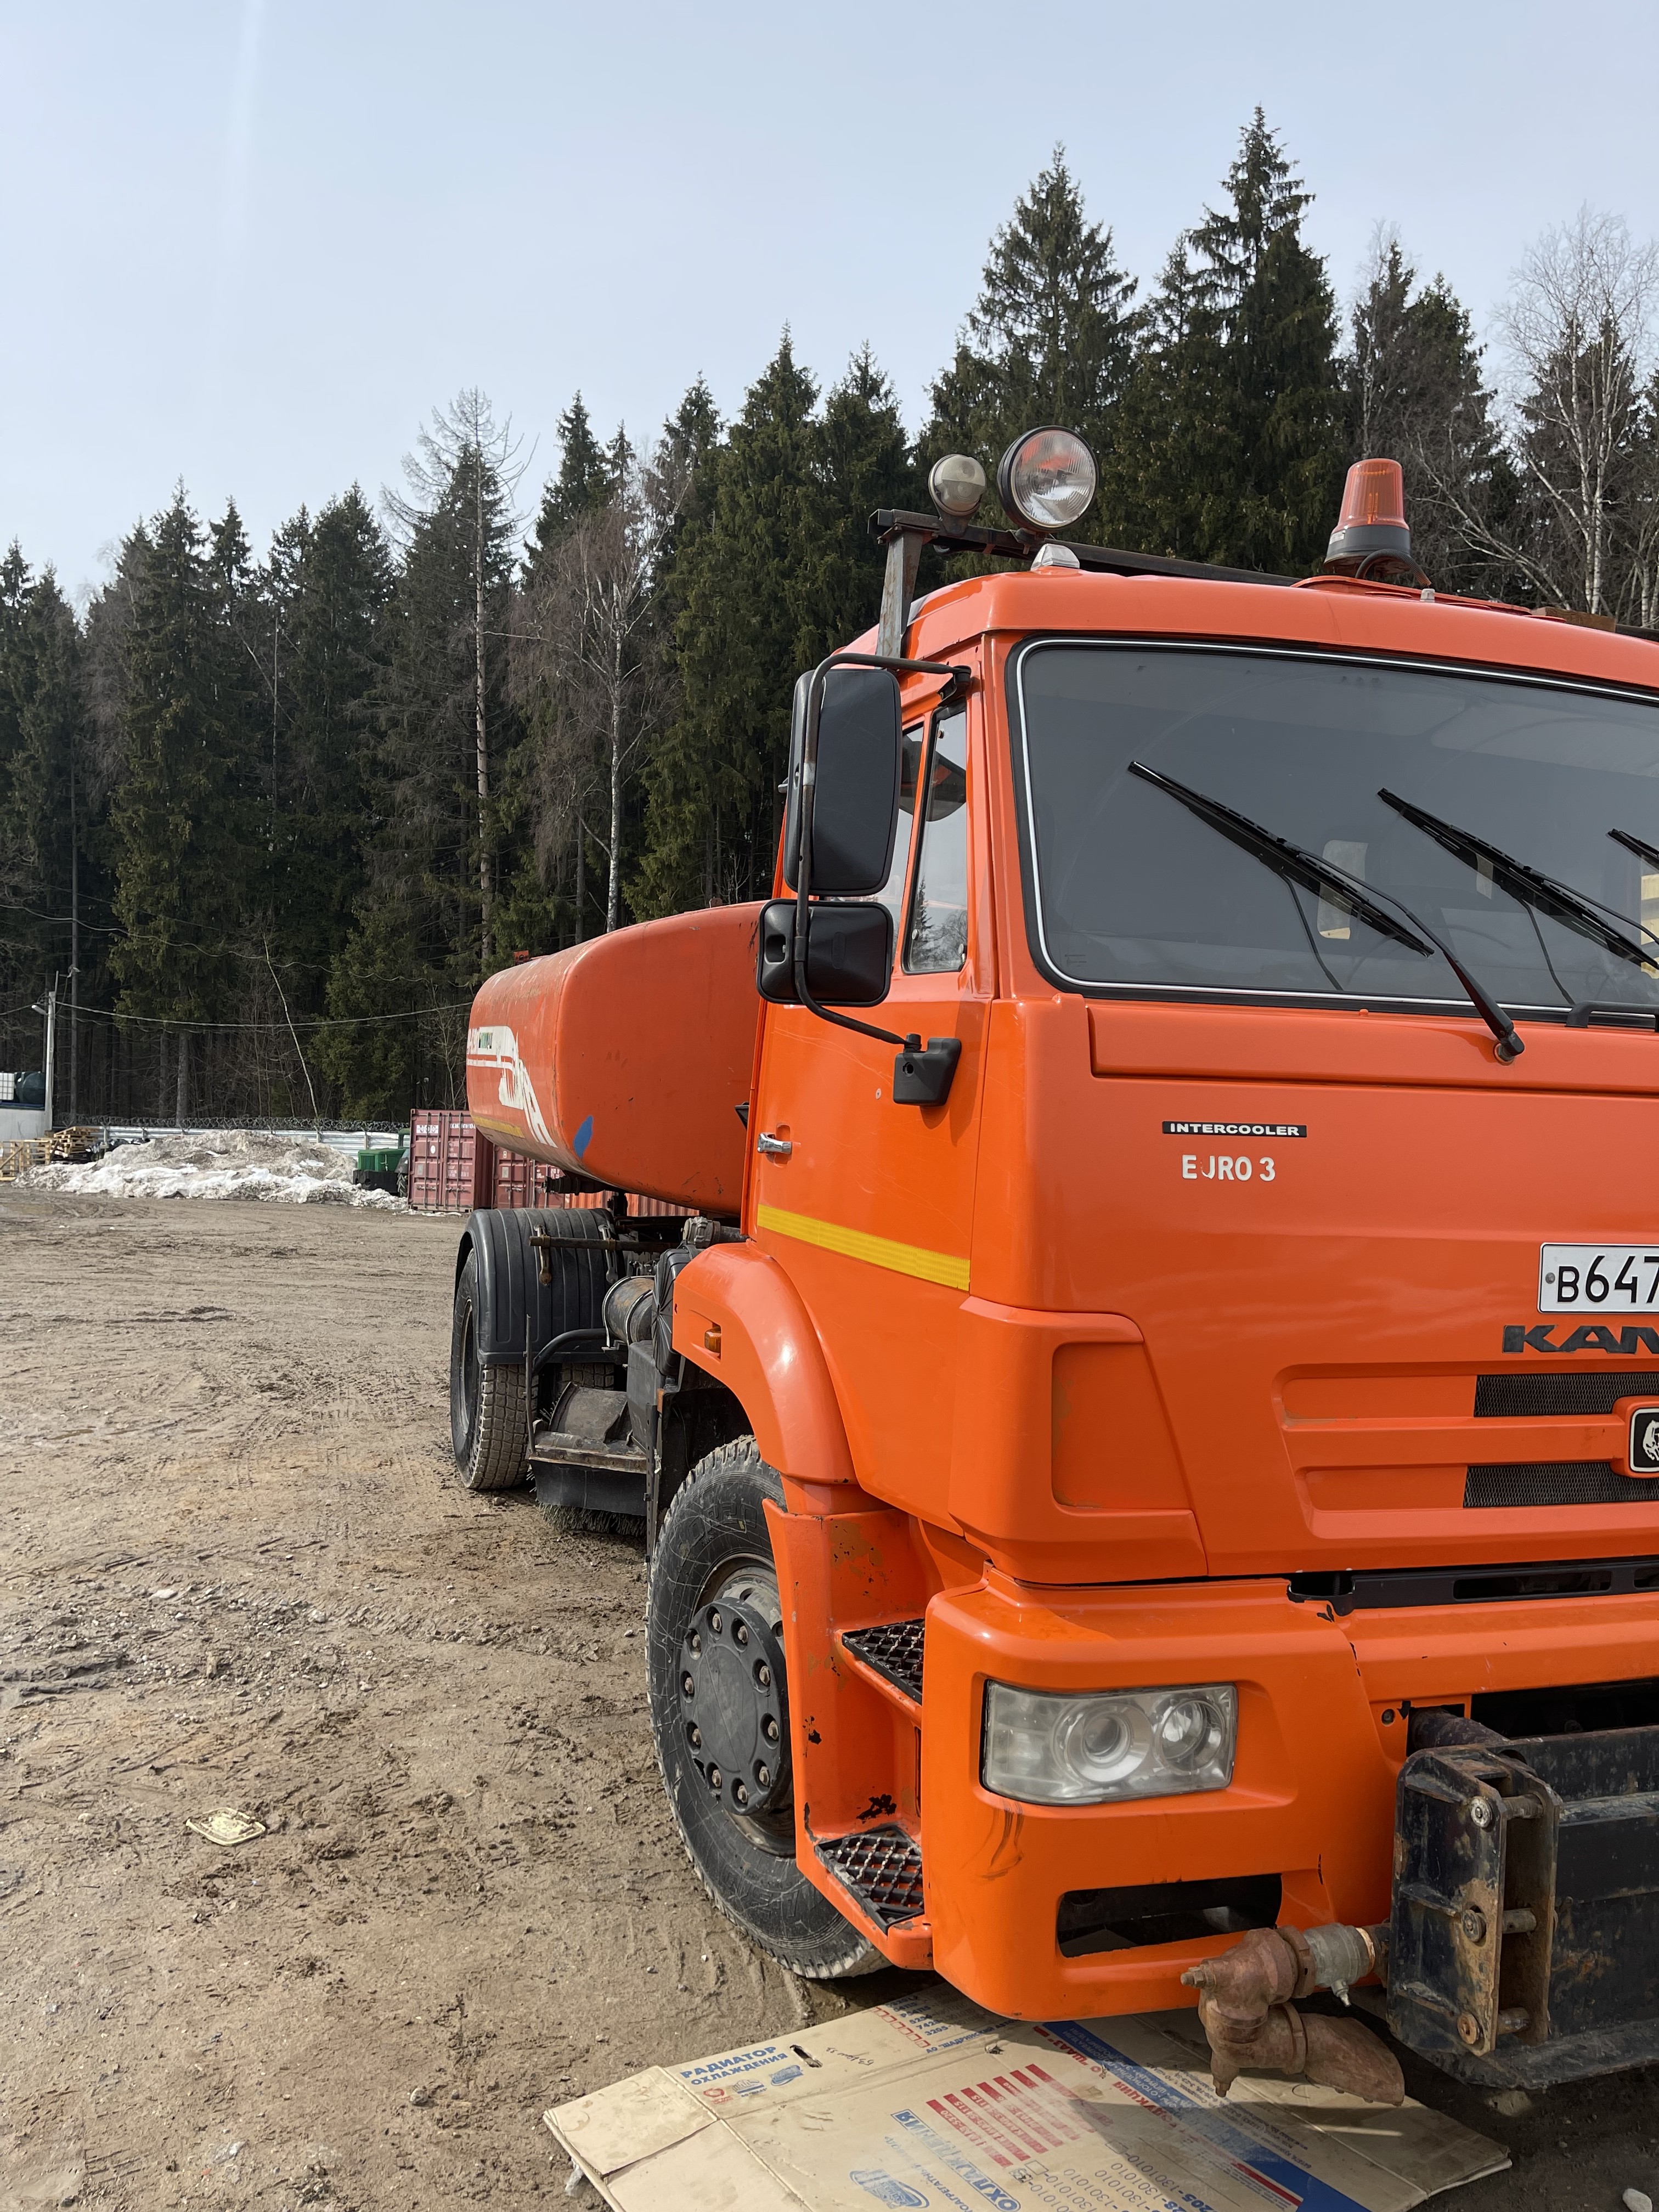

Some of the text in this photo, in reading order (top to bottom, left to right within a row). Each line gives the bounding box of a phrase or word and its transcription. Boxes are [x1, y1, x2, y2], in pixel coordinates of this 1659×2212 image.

[1170, 1123, 1300, 1136] INTERCOOLER
[1259, 1156, 1276, 1182] 3
[680, 2046, 776, 2079] РАДИАТОР
[1047, 2038, 1088, 2066] "ШААЗ"
[691, 2053, 788, 2085] ОХЛАЖДЕНИЯ
[1117, 2067, 1158, 2098] ОТОПИТЕЛИ
[894, 2111, 1018, 2210] ОХЛАЖДЕНИЯ
